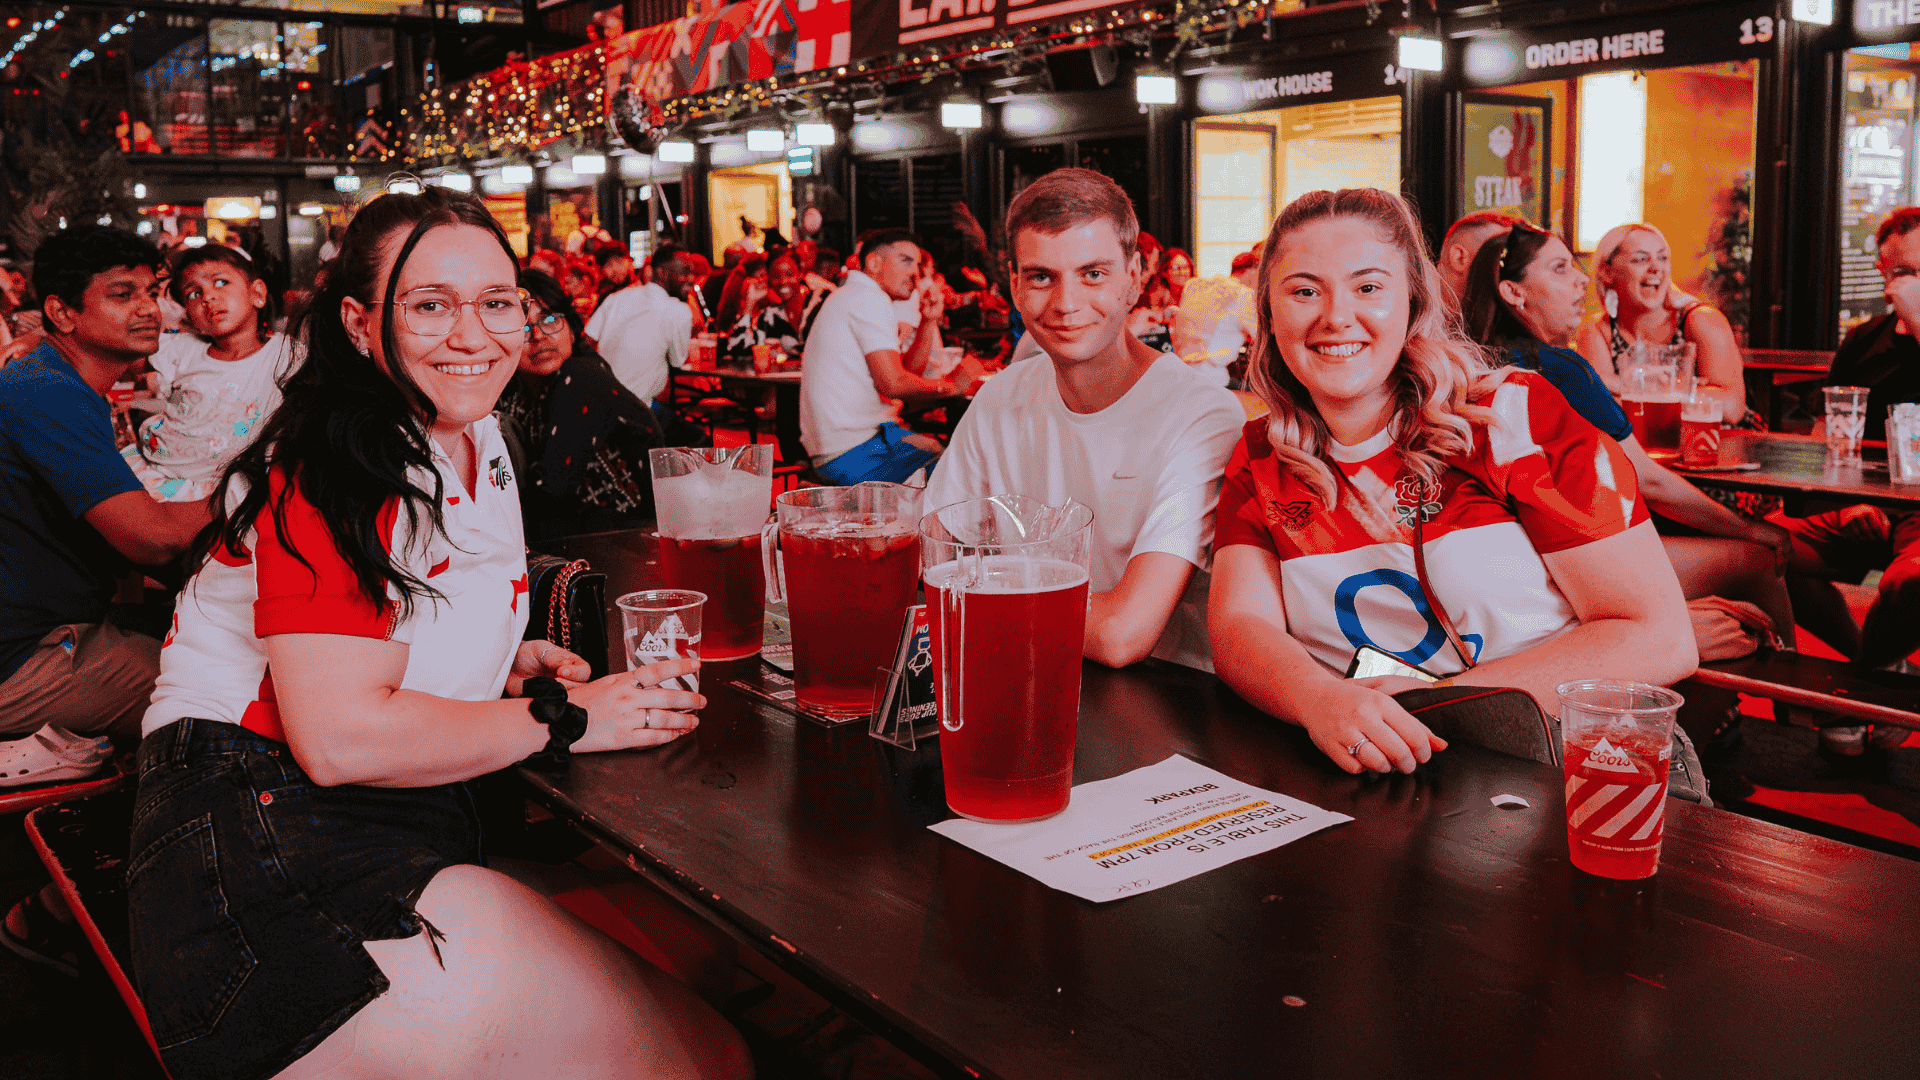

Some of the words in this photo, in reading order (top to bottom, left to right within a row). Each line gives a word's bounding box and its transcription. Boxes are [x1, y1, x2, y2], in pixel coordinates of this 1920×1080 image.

[1739, 16, 1774, 44] 13
[1525, 38, 1599, 69] ORDER
[1602, 29, 1664, 60] HERE
[1241, 77, 1278, 100] WOK
[1279, 71, 1333, 97] HOUSE
[1588, 749, 1631, 767] Coors
[1144, 783, 1220, 805] BOXPARK
[1193, 804, 1287, 836] RESERVED
[1263, 813, 1308, 829] THIS
[1137, 834, 1196, 856] FROM
[1206, 825, 1269, 847] TABLE
[1186, 843, 1211, 853] IS
[1095, 852, 1141, 869] 7PM
